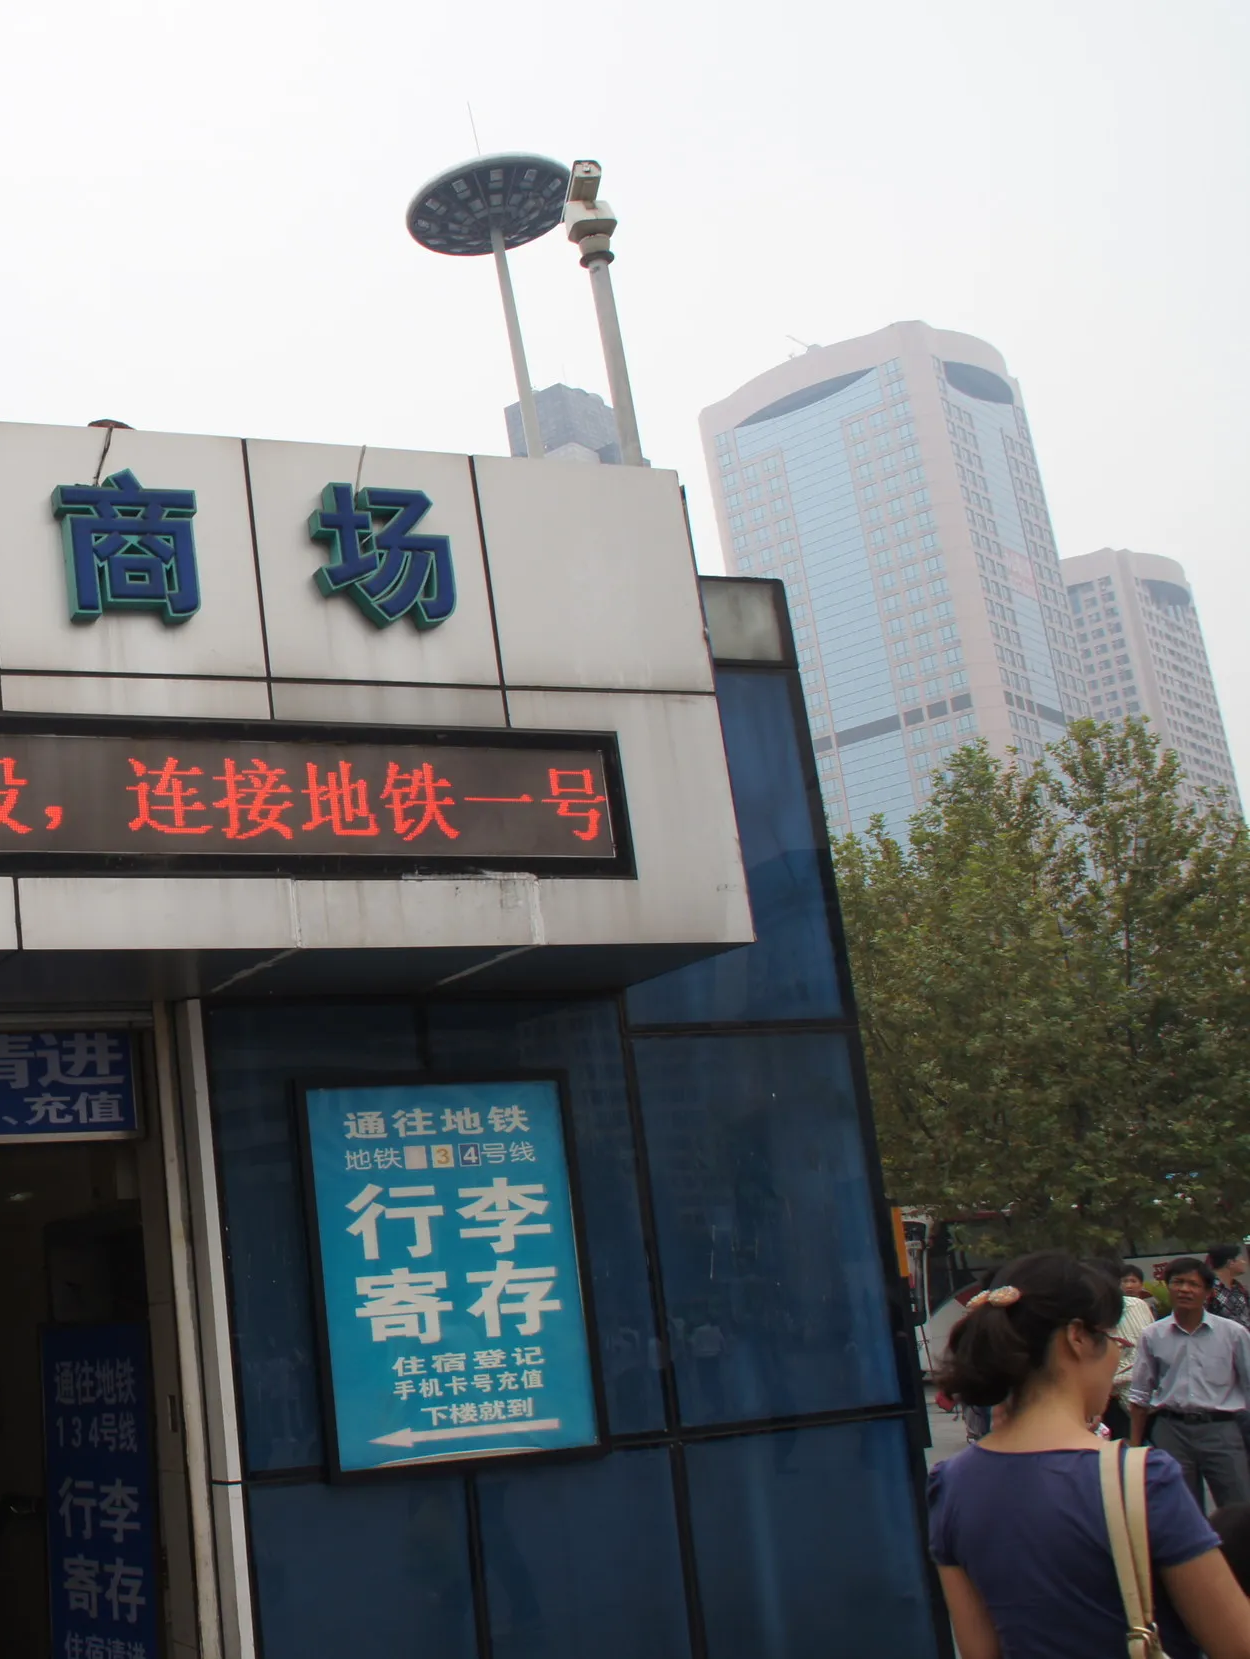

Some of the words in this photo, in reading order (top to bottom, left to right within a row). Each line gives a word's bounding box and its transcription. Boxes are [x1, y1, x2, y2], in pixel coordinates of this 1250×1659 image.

[343, 1104, 530, 1139] 通往地铁
[345, 1177, 553, 1260] 行李
[355, 1260, 562, 1344] 寄存
[54, 1357, 137, 1405] 通往地铁
[392, 1346, 545, 1377] 住宿登记
[393, 1369, 544, 1401] 手机卡号充值
[421, 1397, 533, 1426] 下楼就到
[58, 1476, 141, 1543] 行李
[63, 1553, 146, 1624] 寄存
